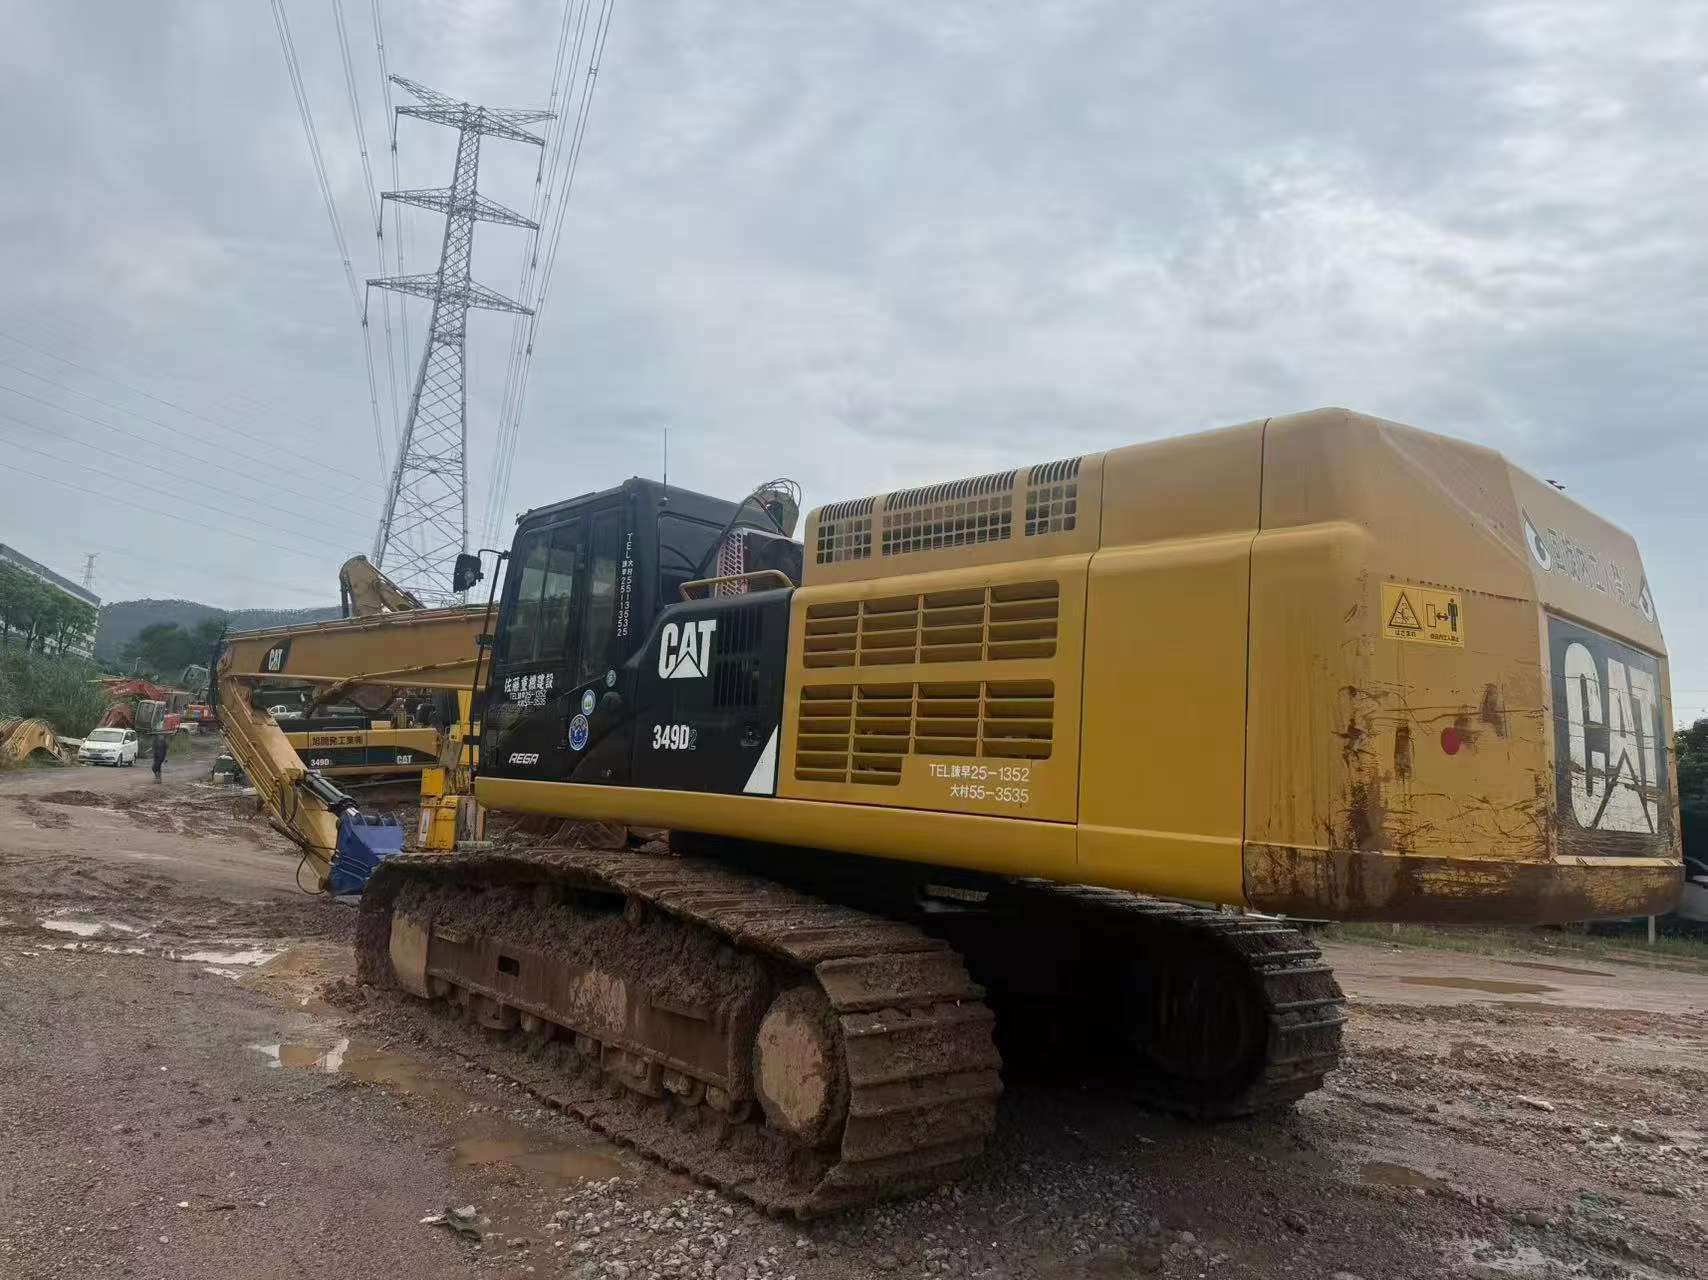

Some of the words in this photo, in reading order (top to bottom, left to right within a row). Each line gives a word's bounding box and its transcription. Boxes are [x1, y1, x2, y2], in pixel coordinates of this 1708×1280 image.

[268, 648, 284, 671] CAT
[658, 619, 717, 679] CAT
[1565, 642, 1659, 834] CAT
[396, 754, 413, 765] CAT
[508, 752, 540, 765] REGA
[949, 783, 1030, 804] 大村55-3535
